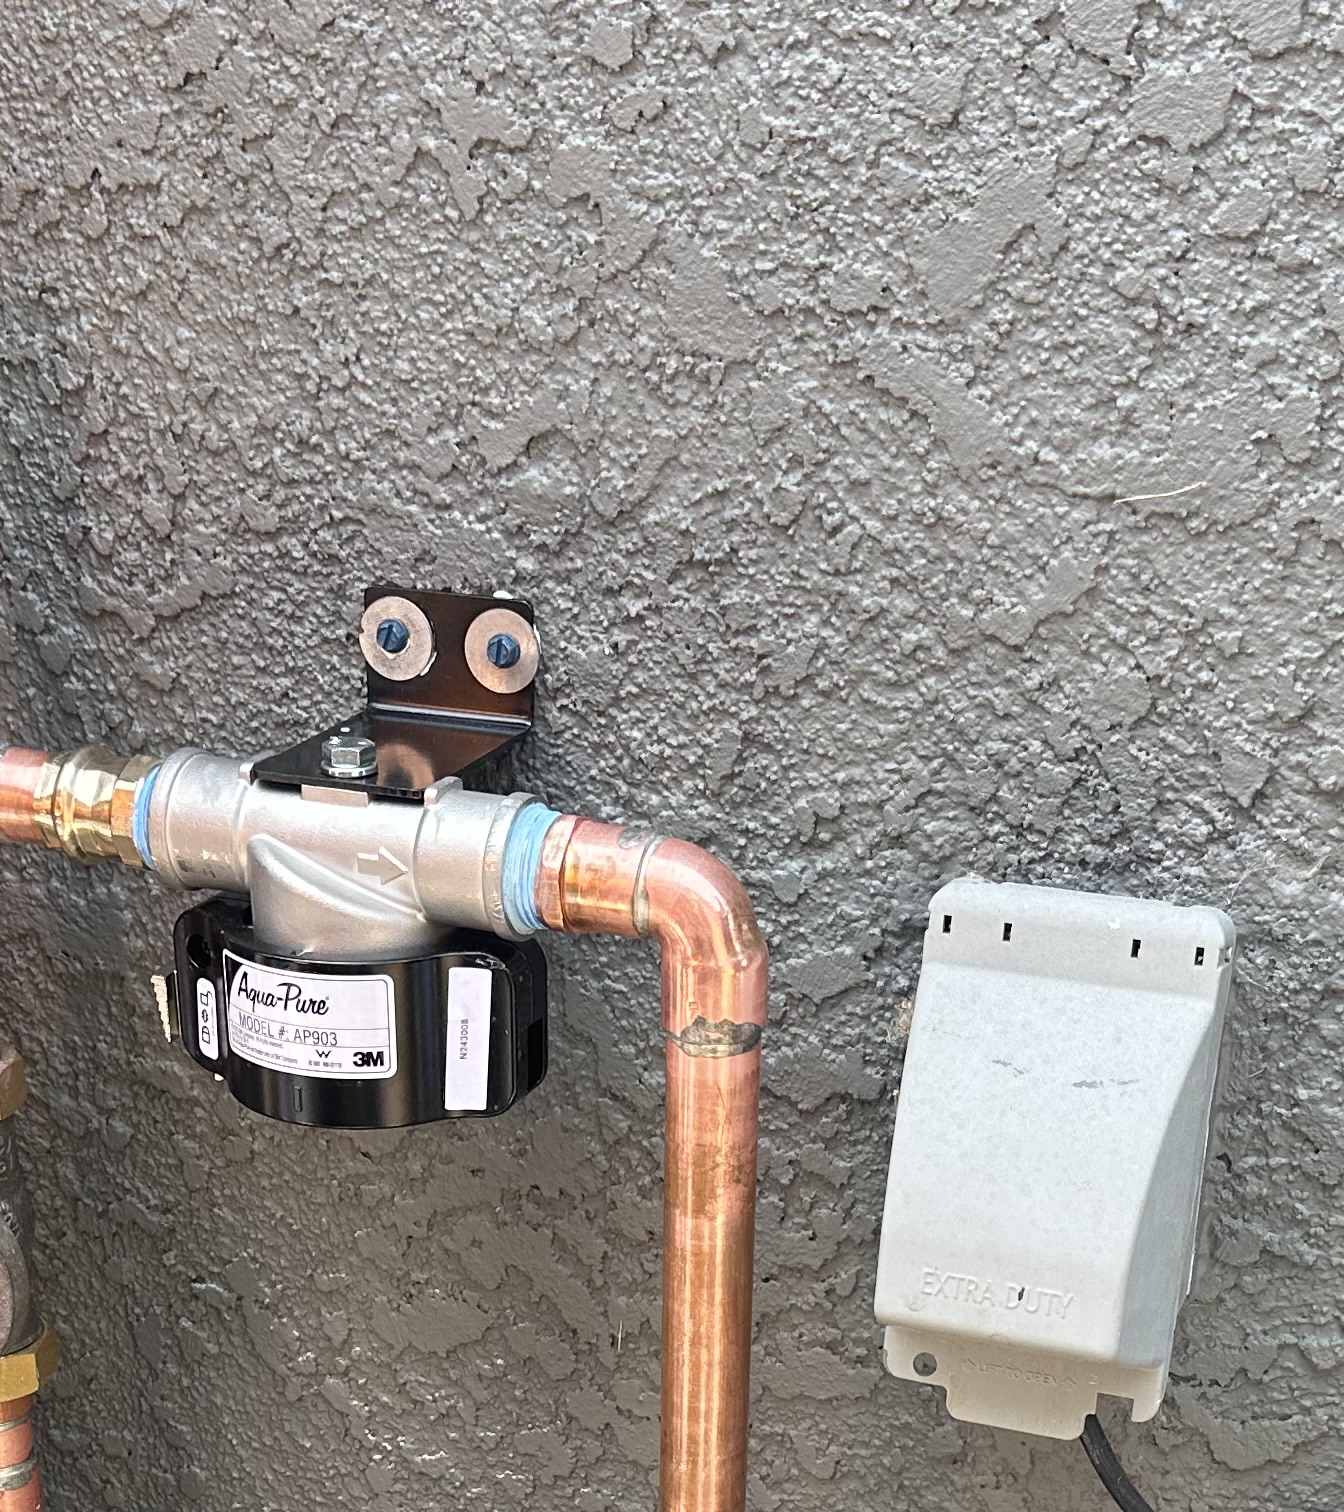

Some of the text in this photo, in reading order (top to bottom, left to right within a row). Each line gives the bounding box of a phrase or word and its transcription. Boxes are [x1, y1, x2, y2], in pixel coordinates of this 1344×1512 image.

[238, 1011, 275, 1039] MODEL
[293, 1028, 338, 1047] AP903
[352, 1050, 385, 1068] 3M
[920, 1266, 1076, 1320] EXTRA DUTY
